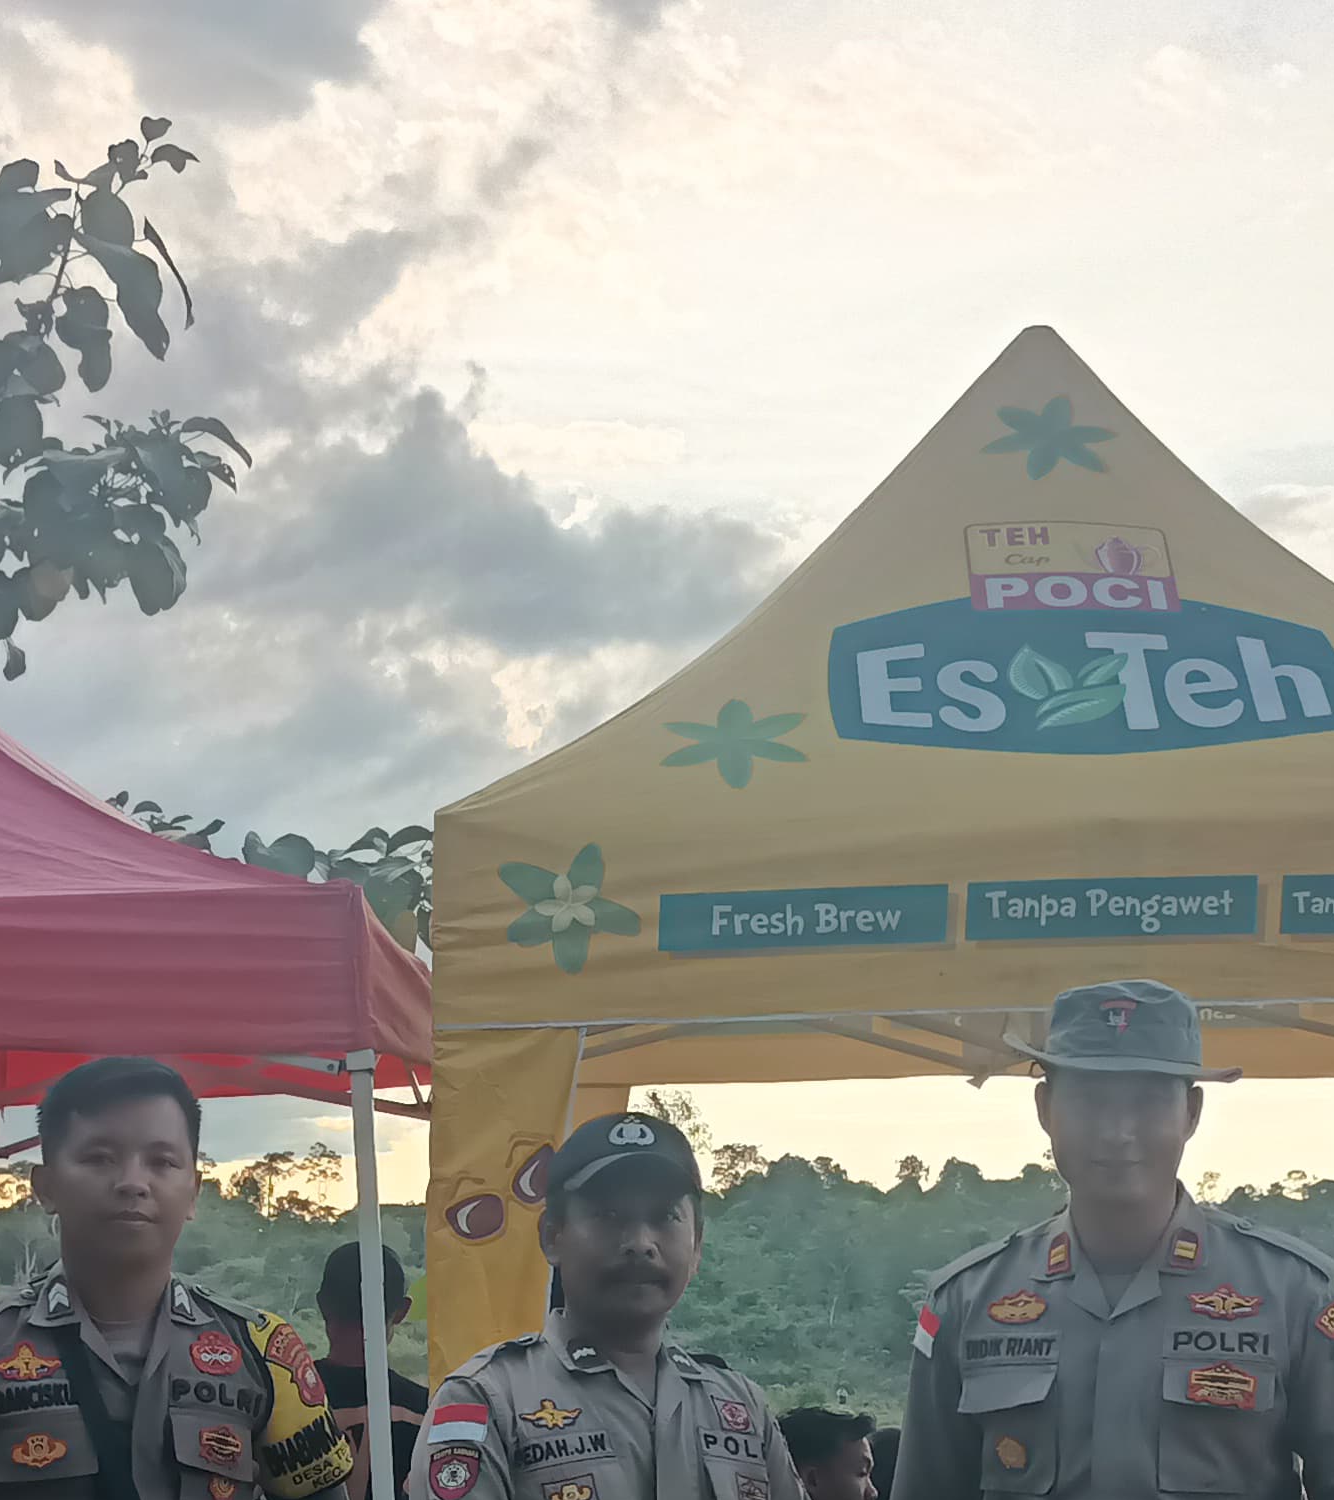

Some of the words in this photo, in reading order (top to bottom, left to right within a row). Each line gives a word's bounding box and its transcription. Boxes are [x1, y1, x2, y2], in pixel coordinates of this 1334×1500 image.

[979, 526, 1050, 547] TEH
[1004, 552, 1050, 567] Cap
[984, 575, 1168, 610] POCI
[856, 642, 1007, 733] Es
[1084, 631, 1332, 730] Teh
[711, 903, 804, 937] Fresh
[814, 902, 902, 935] Brew
[984, 889, 1077, 927] Tanpa
[1085, 888, 1234, 933] Pengawet
[1173, 1330, 1270, 1356] POLRI
[172, 1378, 264, 1419] POLRI
[292, 1460, 334, 1486] DESA
